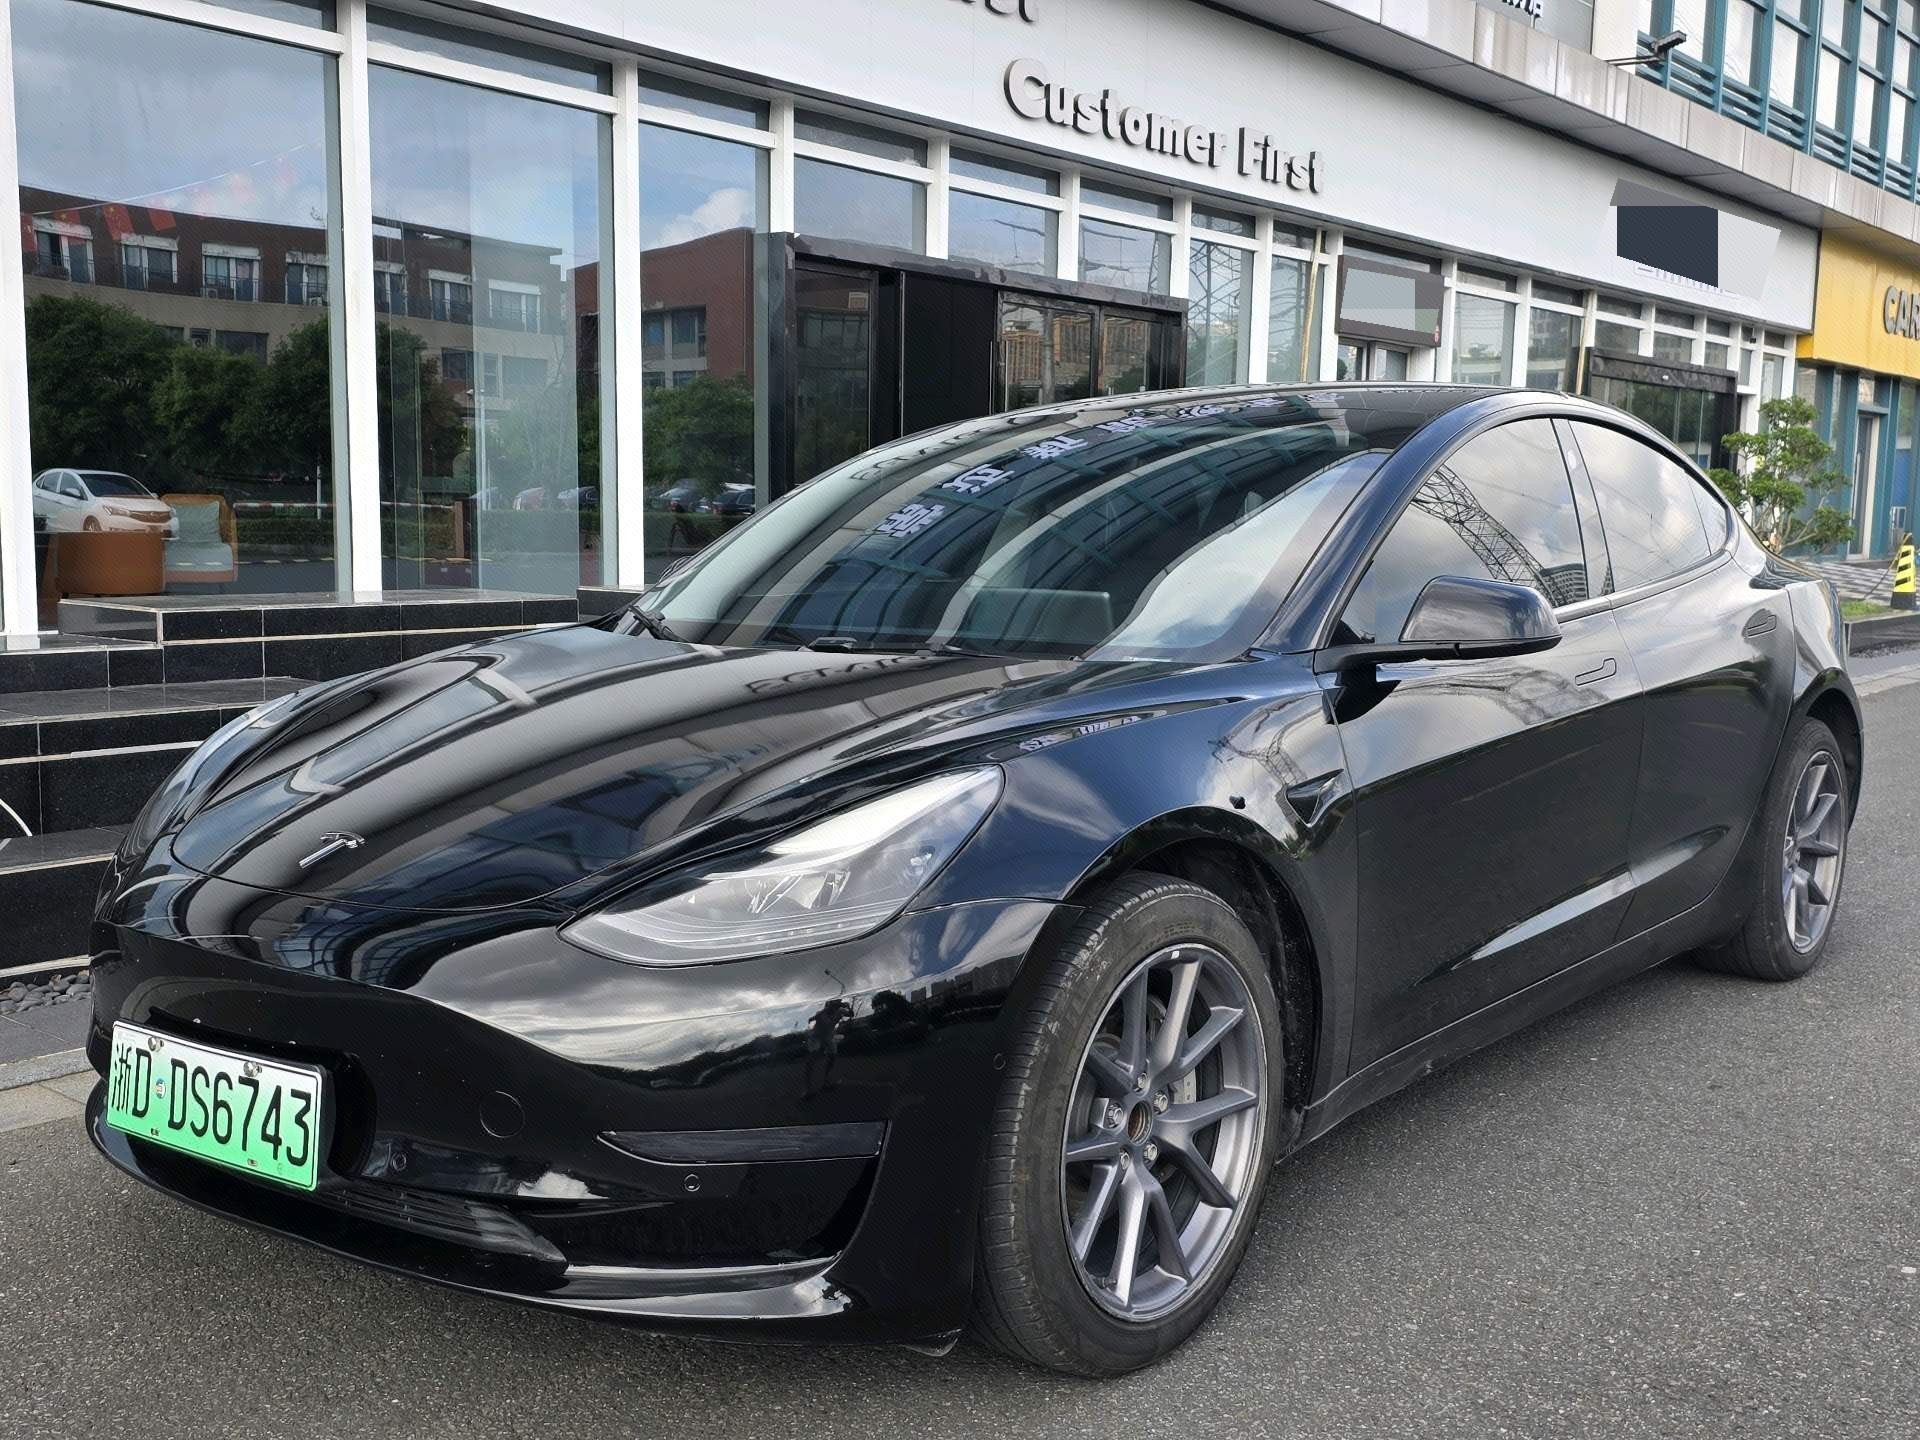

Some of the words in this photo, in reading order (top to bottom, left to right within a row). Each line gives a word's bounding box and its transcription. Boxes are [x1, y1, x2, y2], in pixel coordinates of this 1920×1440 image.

[1003, 57, 1227, 168] Customer
[1237, 126, 1325, 194] First
[167, 1057, 312, 1167] DS6743
